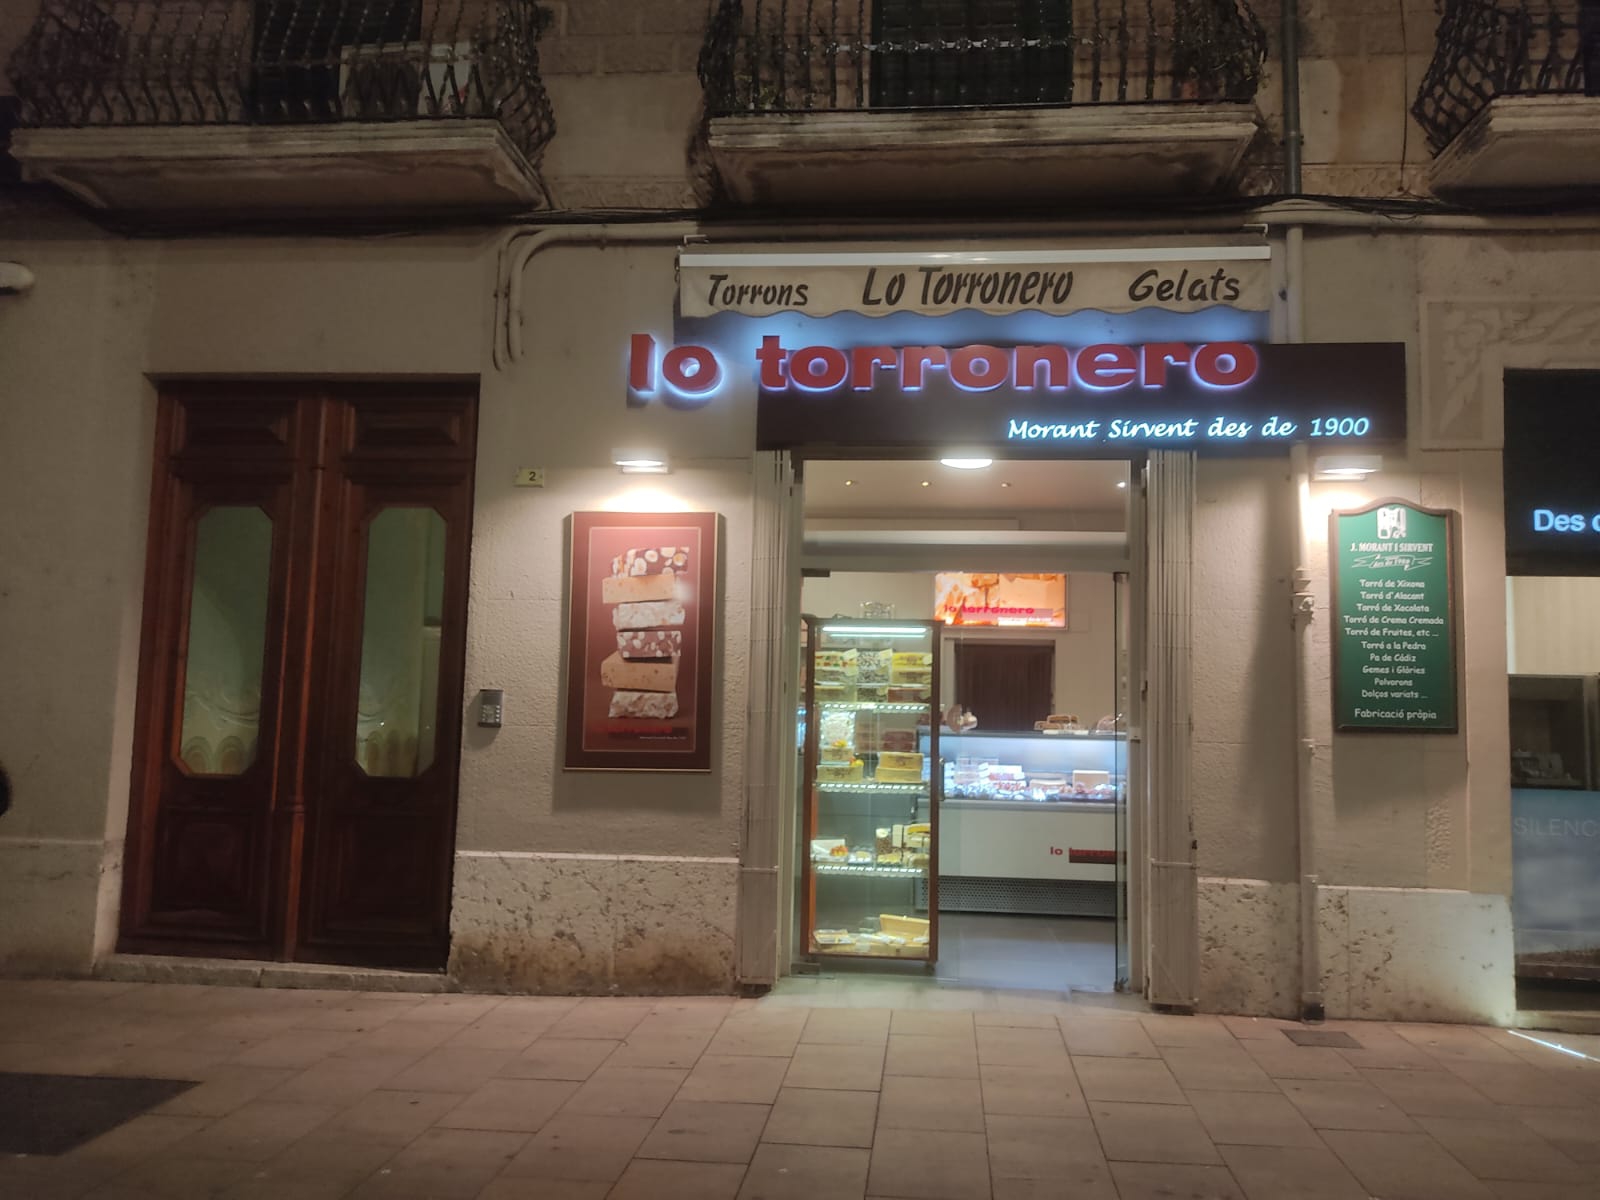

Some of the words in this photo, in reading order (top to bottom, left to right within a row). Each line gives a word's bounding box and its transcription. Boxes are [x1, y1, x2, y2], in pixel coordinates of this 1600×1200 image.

[707, 273, 809, 306] Torrons
[862, 267, 906, 306] Lo
[918, 266, 1074, 306] Torronero
[1128, 268, 1240, 302] Gelats
[629, 333, 722, 397] lo
[756, 335, 1259, 391] torronero
[1008, 419, 1100, 439] Morant
[1108, 418, 1199, 438] Sirvent
[1207, 416, 1252, 438] des
[1261, 416, 1298, 437] de
[1309, 417, 1370, 437] 1900
[529, 471, 536, 481] 2
[1533, 509, 1586, 532] Des
[1359, 542, 1393, 553] MORANT
[1399, 543, 1434, 554] SIRVENT
[1384, 580, 1395, 588] de
[1382, 603, 1393, 612] de
[1369, 616, 1379, 624] de
[1381, 616, 1407, 624] Crema
[1408, 616, 1444, 625] Cremada
[1370, 628, 1380, 636] de
[1393, 641, 1401, 650] la
[1402, 641, 1427, 650] Pedra
[1369, 653, 1380, 662] Pa
[1381, 653, 1392, 662] de
[1361, 689, 1389, 699] Dolços
[1354, 708, 1404, 719] Fabricació
[1050, 846, 1063, 856] lo
